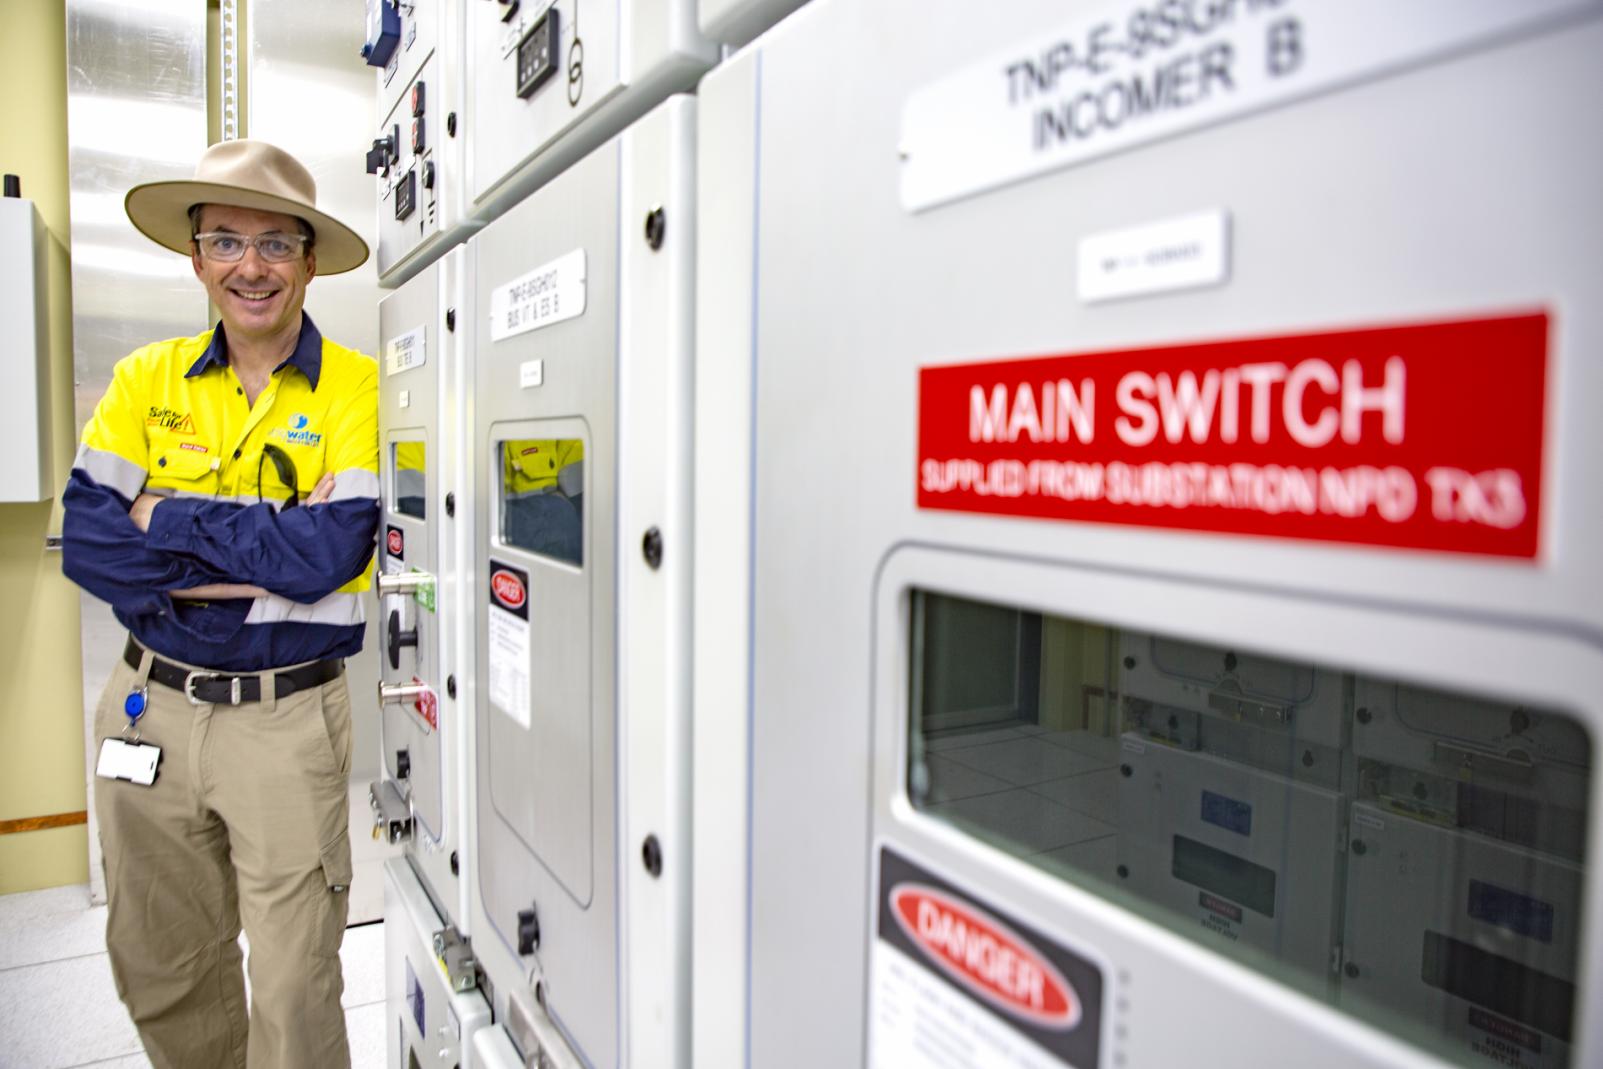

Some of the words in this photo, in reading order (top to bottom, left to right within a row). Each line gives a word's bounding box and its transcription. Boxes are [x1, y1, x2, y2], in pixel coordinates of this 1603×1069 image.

[1033, 41, 1235, 150] INCOMER
[1266, 15, 1304, 78] B
[969, 376, 1096, 445] MAIN
[1114, 354, 1407, 449] SWITCH
[921, 458, 1026, 498] SUPPLIED
[1026, 460, 1104, 501] FROM
[1104, 460, 1318, 516] SUBSTATION
[1423, 465, 1527, 530] TX3
[916, 897, 1046, 1013] DANGER
